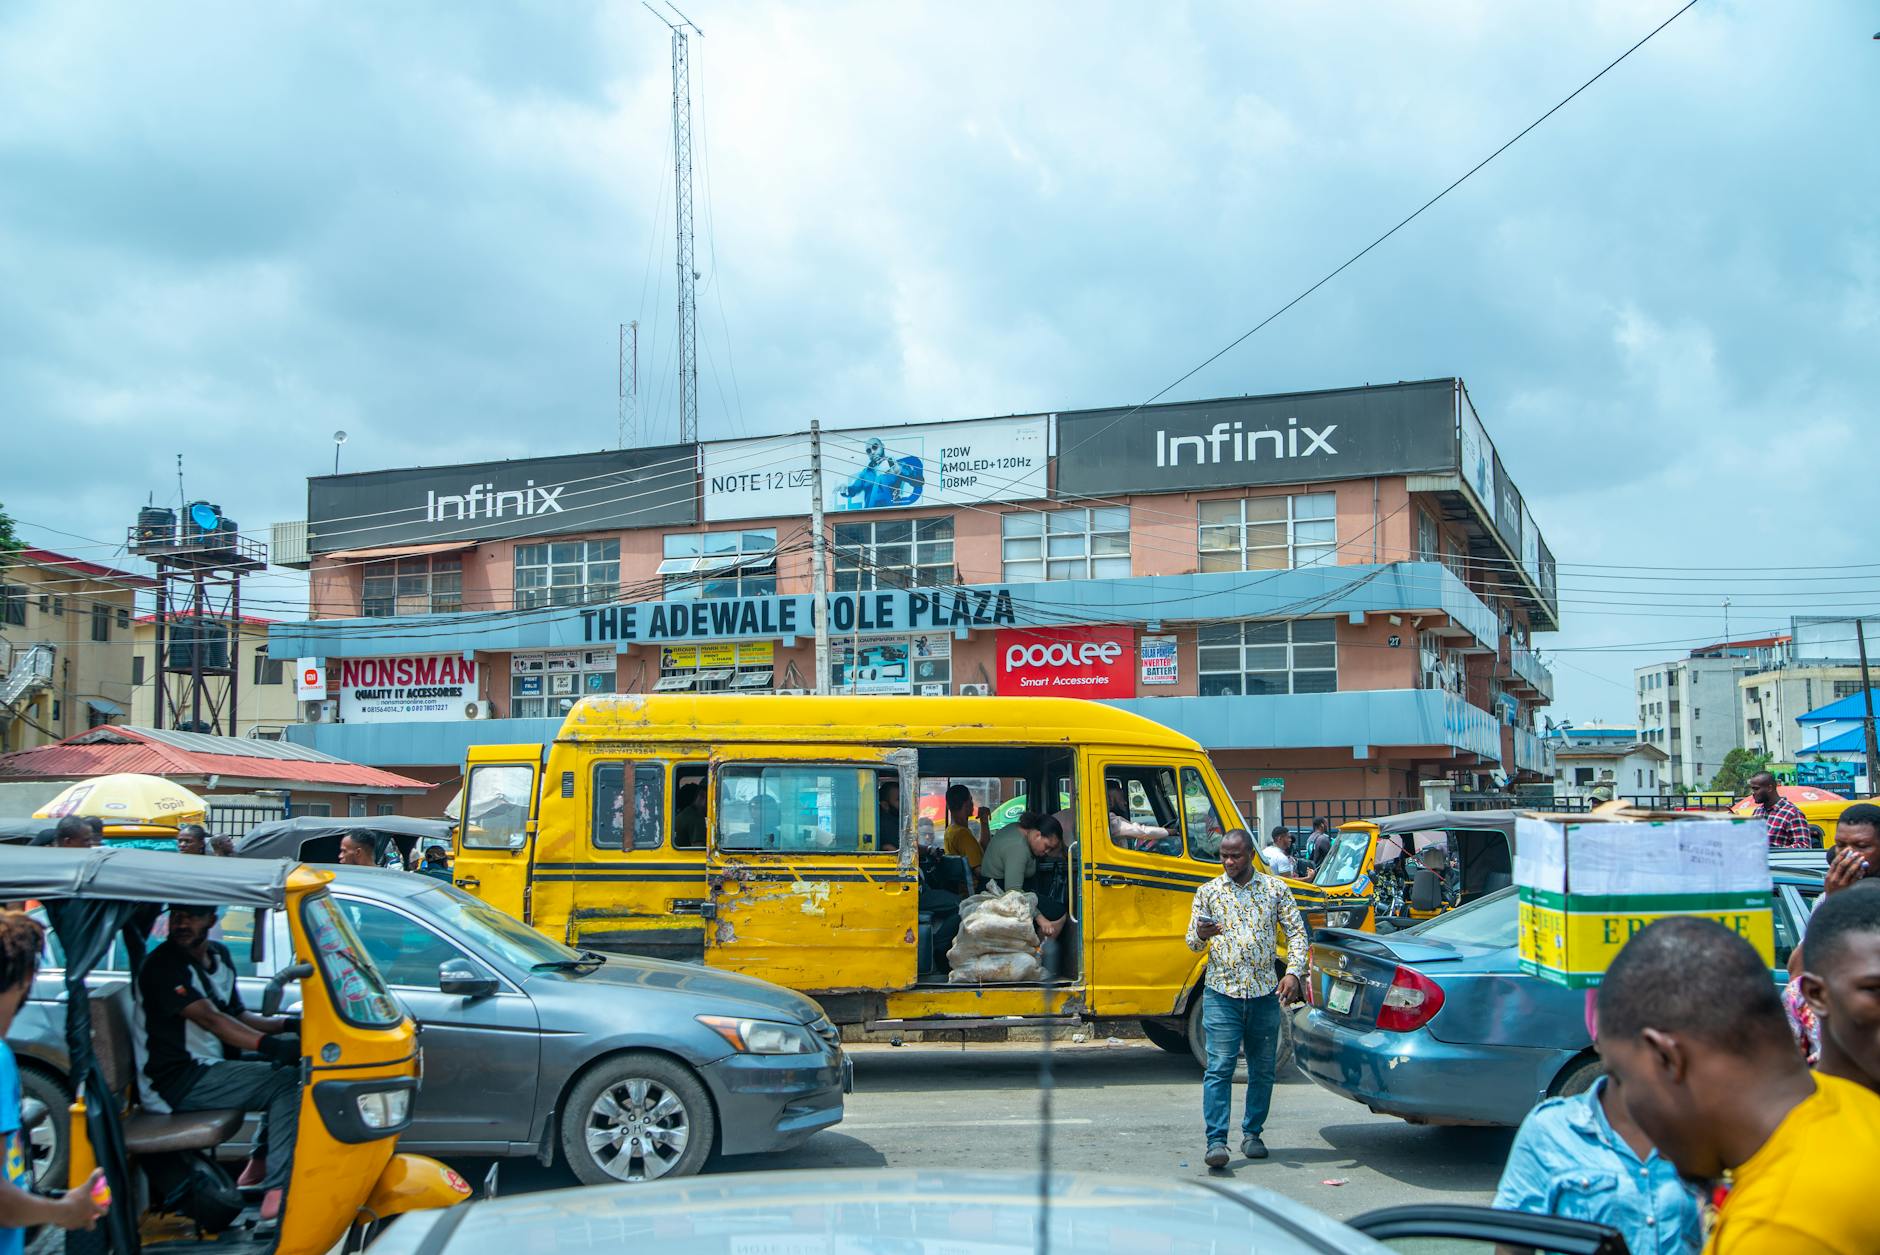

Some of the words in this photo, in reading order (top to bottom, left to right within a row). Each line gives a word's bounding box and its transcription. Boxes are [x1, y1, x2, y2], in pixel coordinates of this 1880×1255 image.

[1156, 417, 1338, 467] Infinix
[942, 446, 971, 458] 120W
[941, 457, 1031, 473] AMOLED+120Hz
[712, 474, 760, 493] NOTE
[766, 472, 784, 490] 12
[942, 476, 977, 488] 108MP
[427, 479, 566, 523] Infinix
[580, 607, 636, 641] THE
[649, 599, 796, 638] ADEWALE
[909, 589, 1015, 627] PLAZA
[1389, 637, 1400, 646] 27
[342, 656, 475, 688] NONSMAN
[1147, 665, 1176, 675] BATTERY
[1020, 676, 1049, 687] Smart
[1052, 675, 1109, 686] Accessories
[355, 689, 392, 701] QUALITY
[395, 688, 403, 699] IT
[406, 687, 462, 699] ACCESSORIES
[154, 799, 184, 811] Topit
